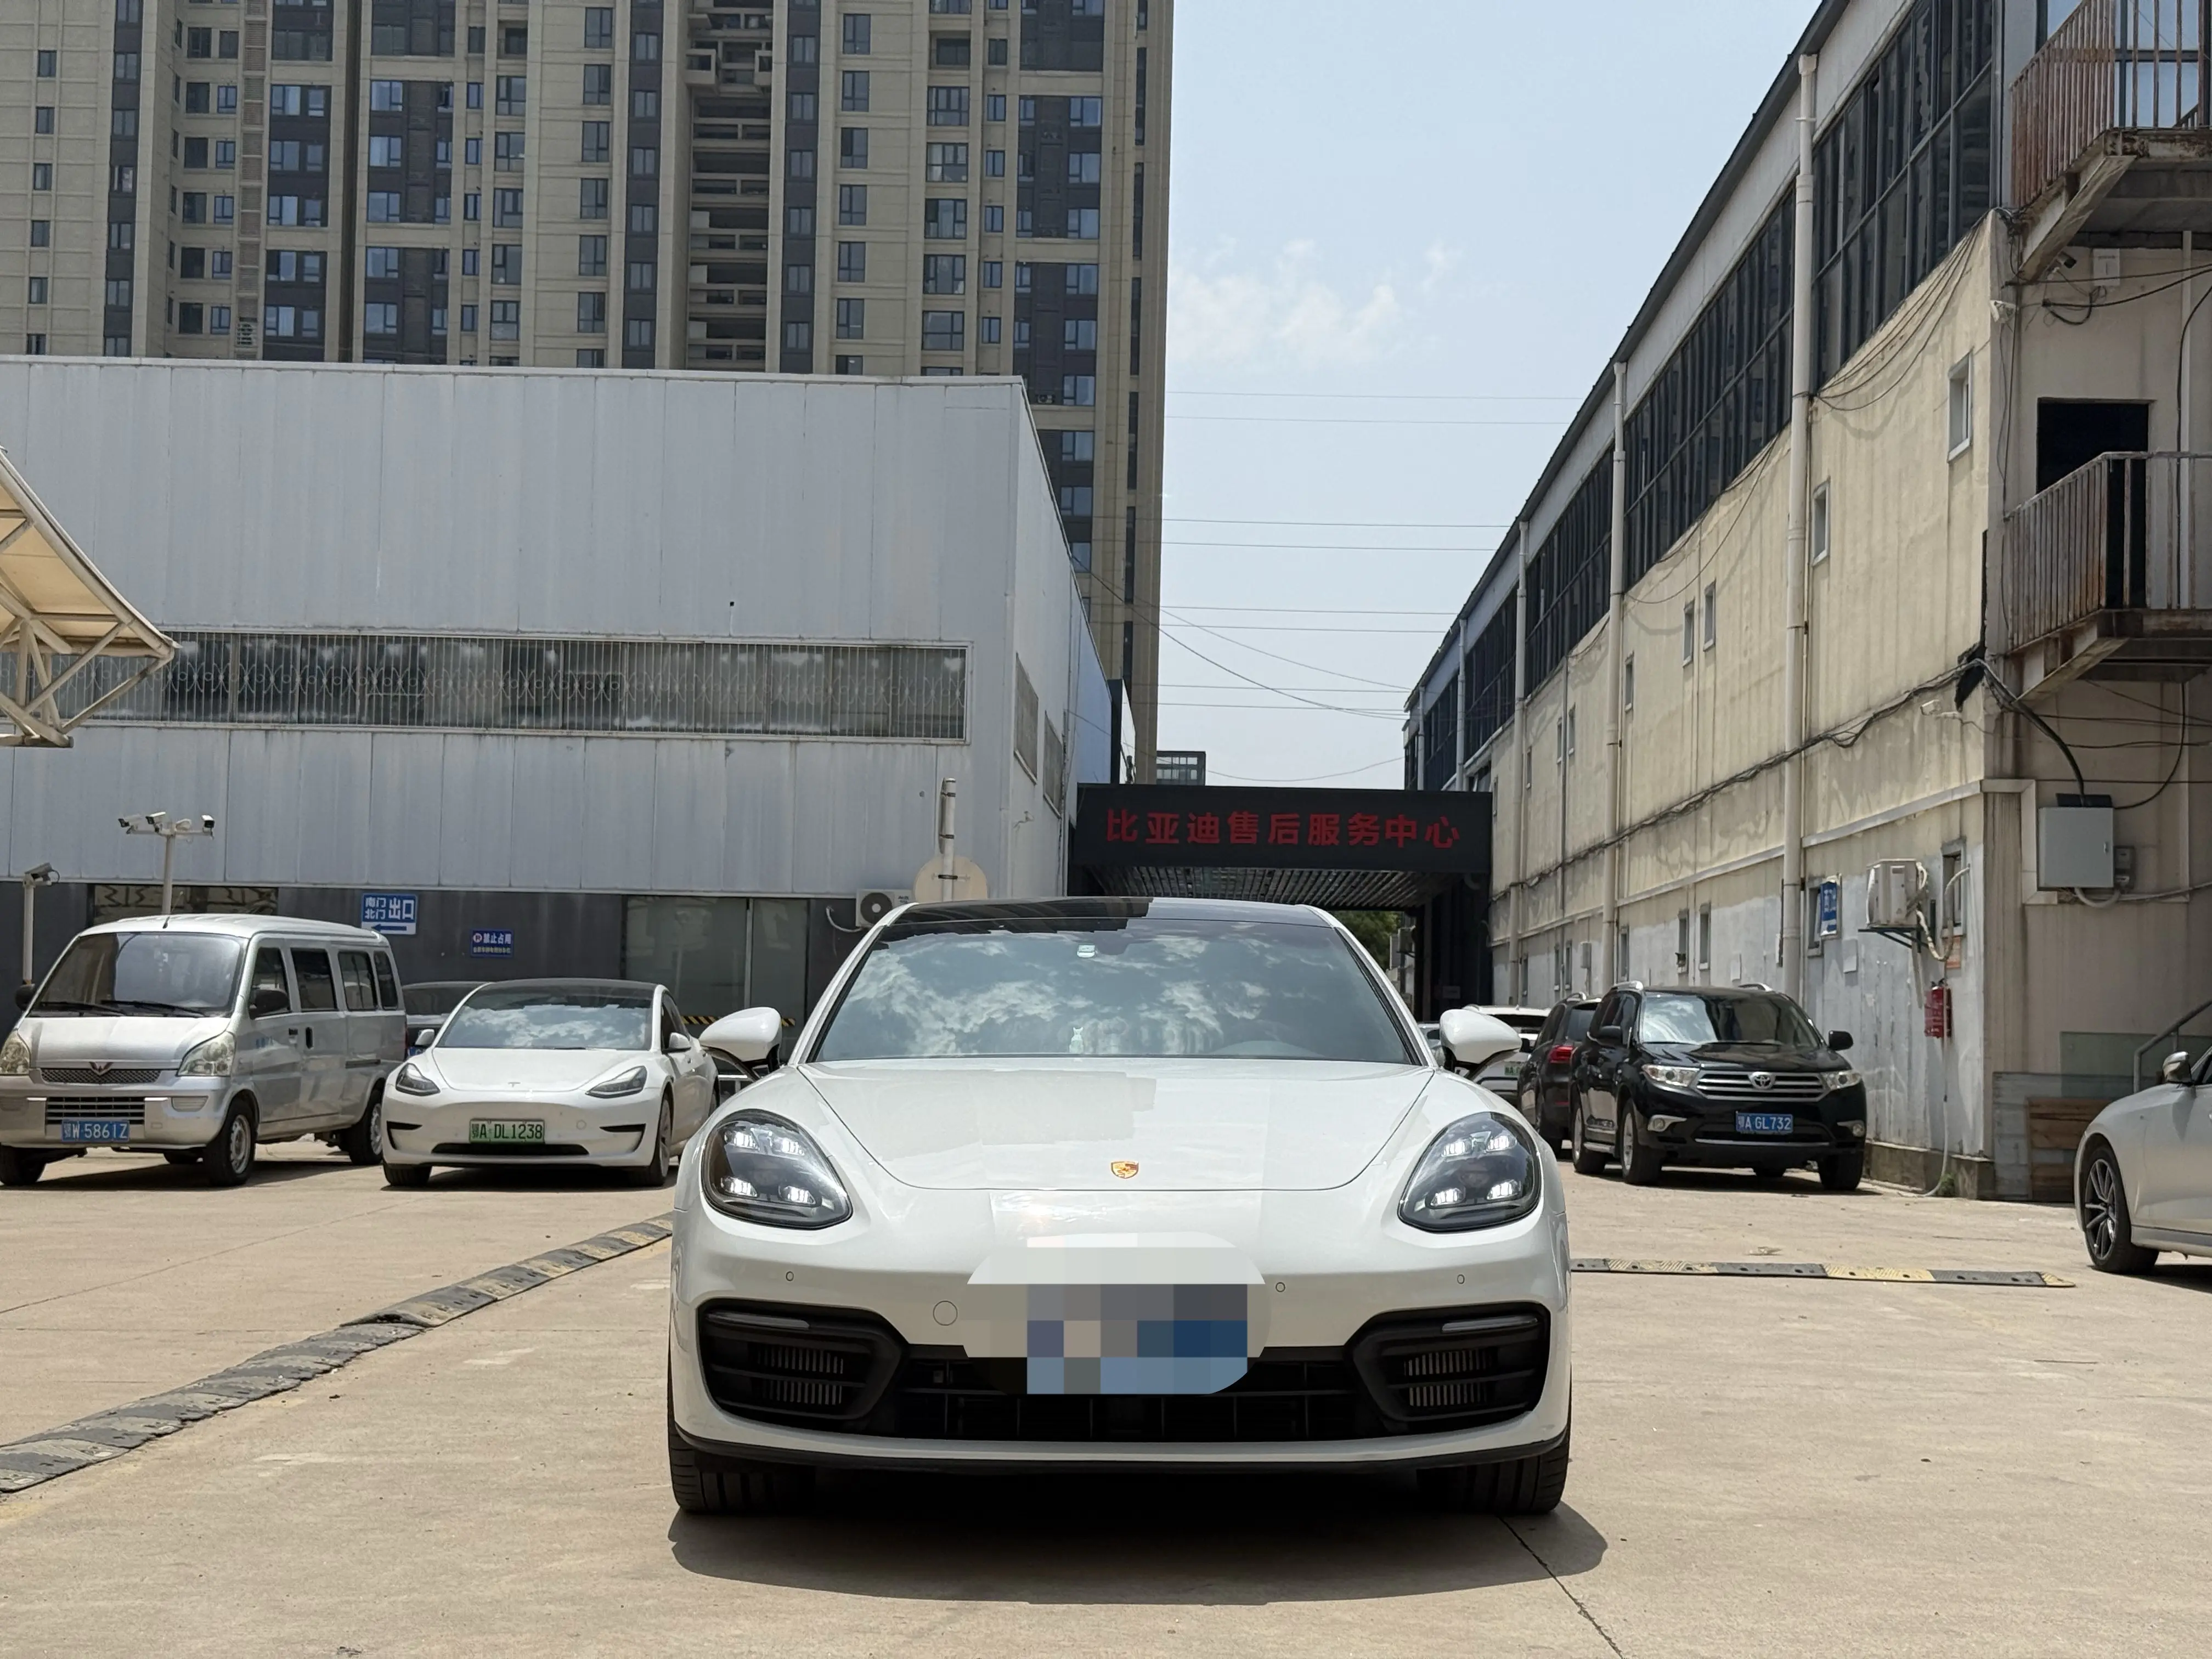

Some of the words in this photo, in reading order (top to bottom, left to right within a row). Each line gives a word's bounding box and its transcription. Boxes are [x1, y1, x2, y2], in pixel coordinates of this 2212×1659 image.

[1107, 809, 1459, 849] 比亚迪售后服务中心
[364, 909, 386, 919] 北门
[388, 897, 414, 920] 出口
